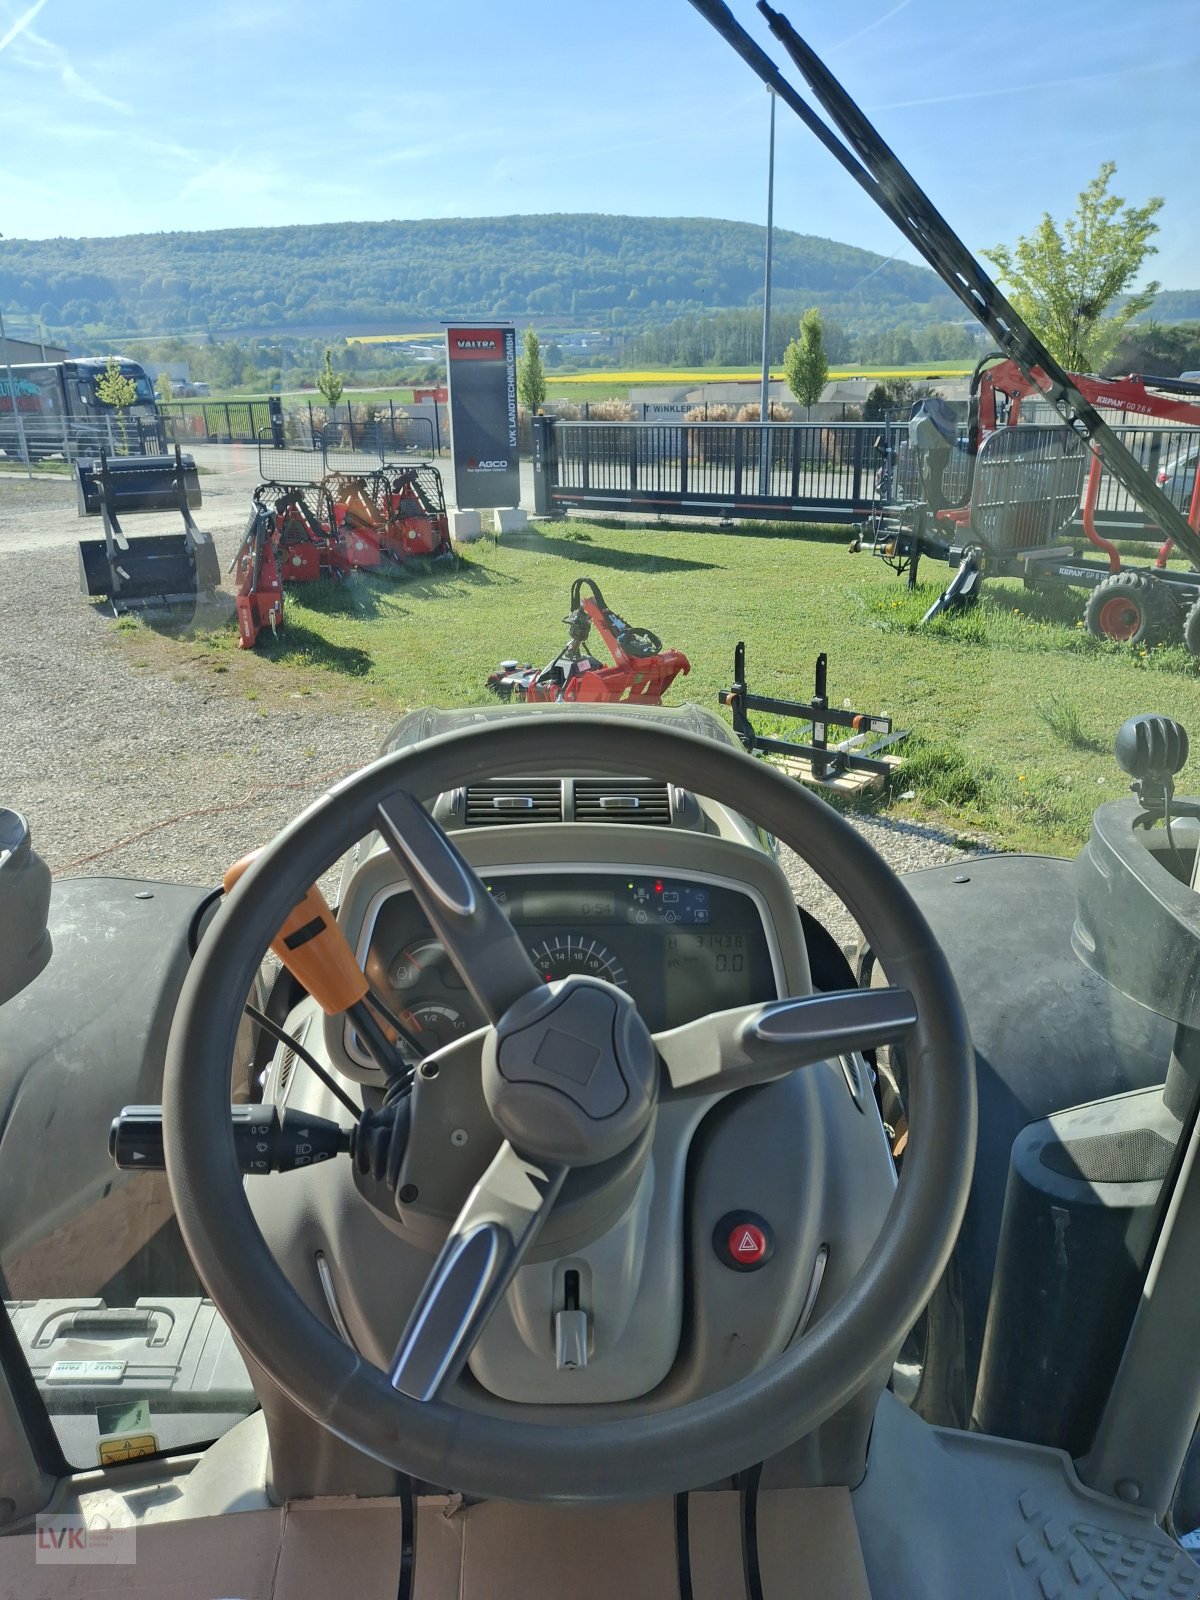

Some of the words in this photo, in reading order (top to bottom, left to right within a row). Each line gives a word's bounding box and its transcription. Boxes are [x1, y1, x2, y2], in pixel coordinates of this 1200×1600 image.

[457, 340, 496, 349] VALTRA
[505, 333, 514, 362] GMBH
[507, 364, 516, 428] LANDTECHNIK
[1096, 395, 1124, 408] KRPAN
[653, 404, 692, 413] WINKLER
[509, 430, 517, 447] LVK
[478, 460, 508, 468] AGCO
[1059, 567, 1083, 578] KRPAN
[540, 961, 550, 969] 12
[715, 954, 743, 972] 0.0
[423, 1014, 438, 1023] 1/2
[452, 1021, 466, 1029] 1/1
